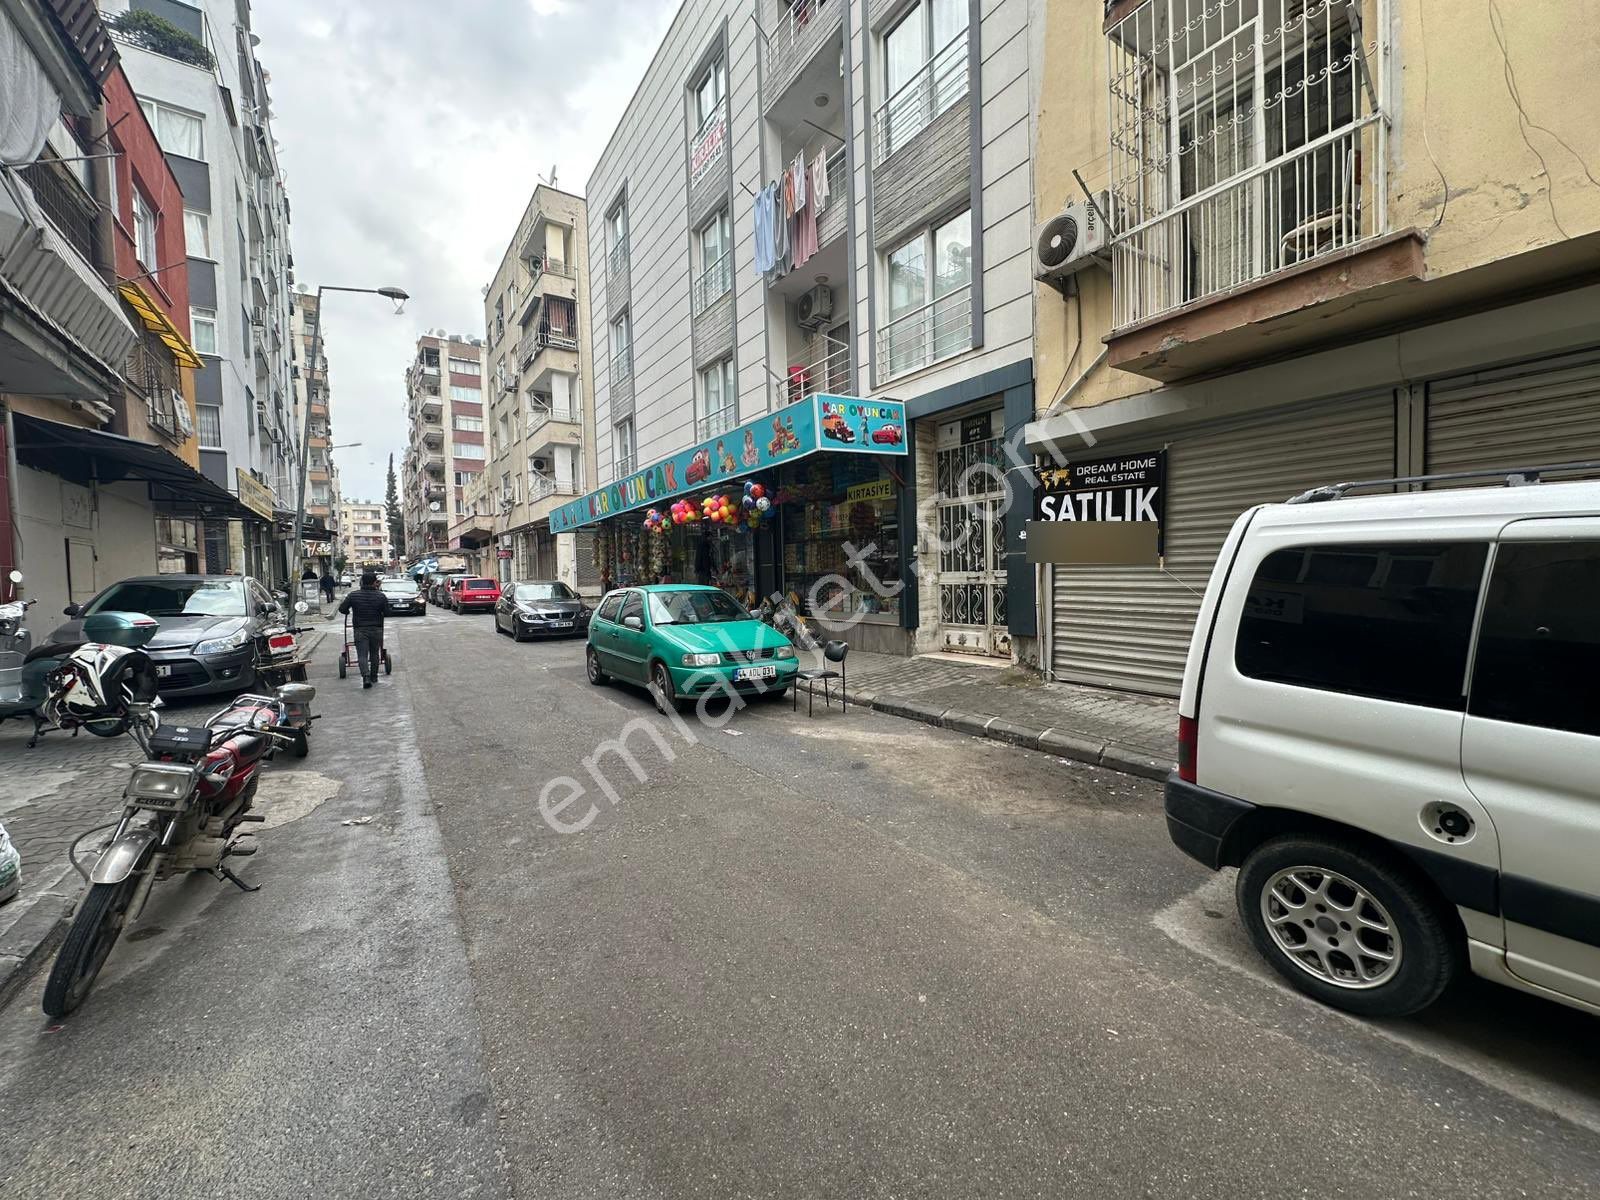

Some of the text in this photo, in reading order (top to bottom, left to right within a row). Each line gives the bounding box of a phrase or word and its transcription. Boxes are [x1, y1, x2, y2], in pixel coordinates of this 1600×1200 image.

[822, 401, 900, 420] KAR OYUNCAK
[1076, 457, 1157, 476] DREAM HOME
[1085, 471, 1146, 485] REAL ESTATE
[588, 460, 678, 519] KAR OYUNCAK
[848, 482, 890, 501] KIRTASİYE
[1040, 486, 1160, 522] SATILIK
[762, 667, 774, 676] 031
